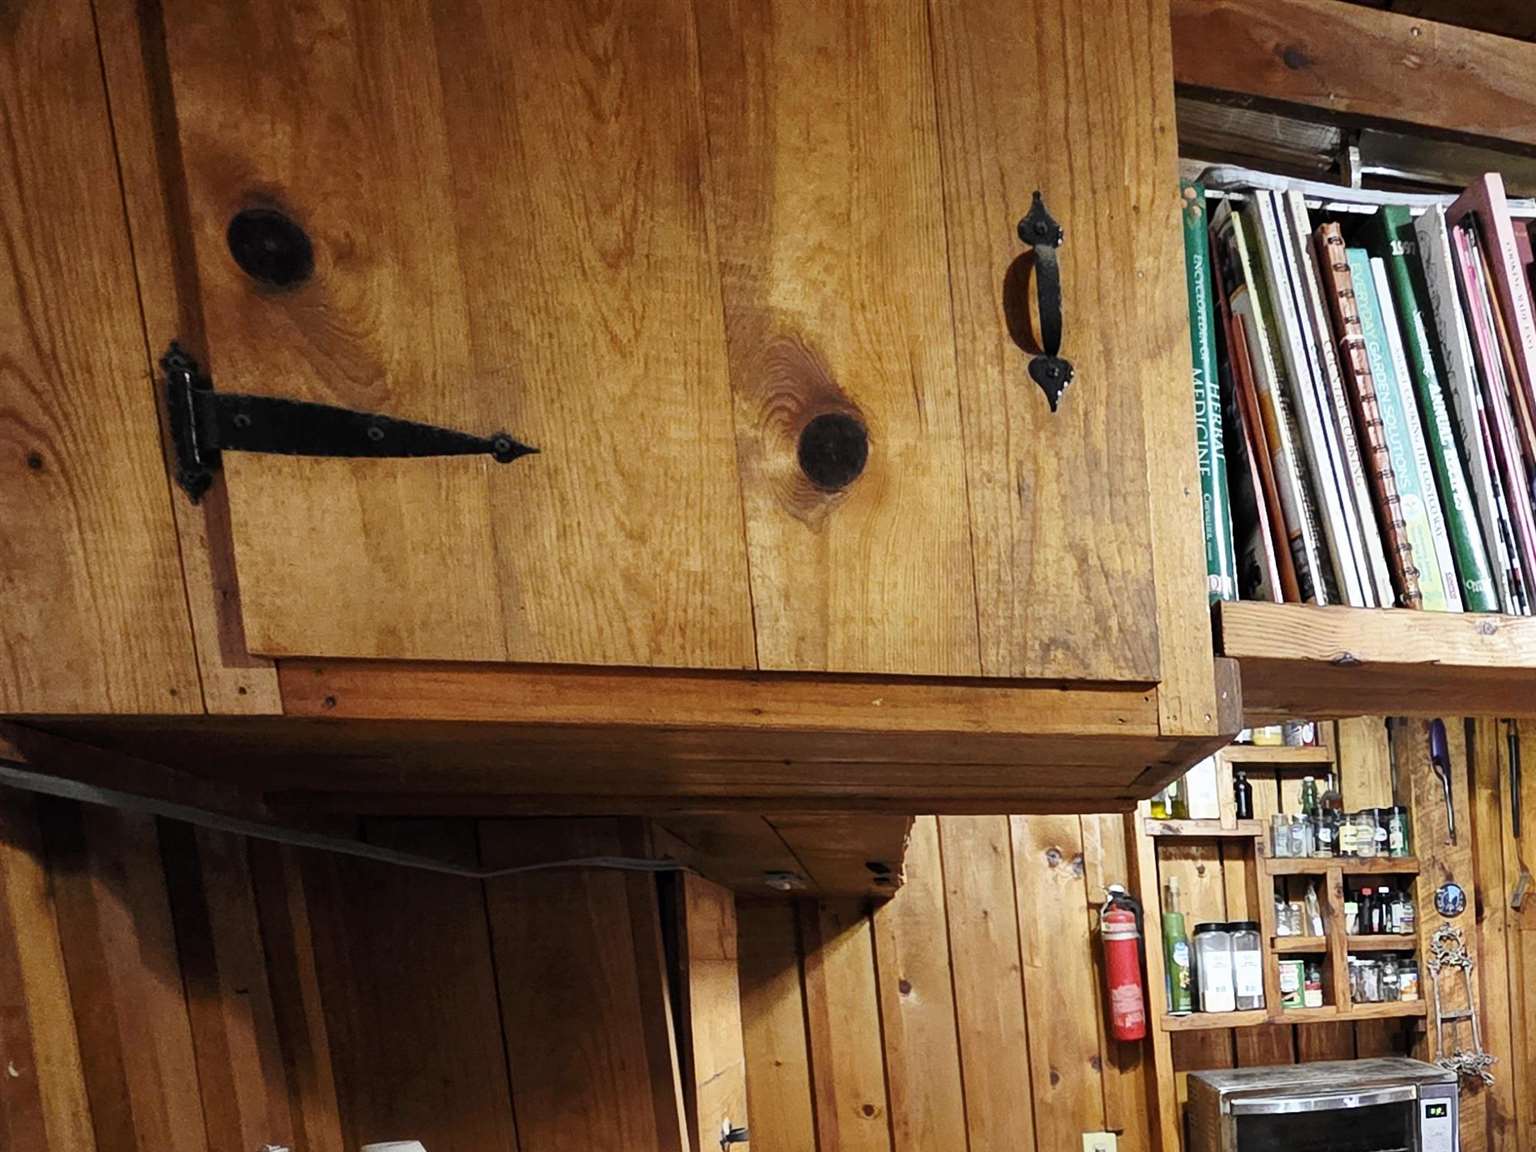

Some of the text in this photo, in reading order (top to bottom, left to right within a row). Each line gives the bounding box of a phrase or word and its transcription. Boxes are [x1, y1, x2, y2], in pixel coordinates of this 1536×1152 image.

[1192, 367, 1211, 477] MEDICINE
[1209, 382, 1226, 462] HERBAL
[1323, 339, 1364, 487] COUNTRY COOKING
[1351, 261, 1411, 490] EVERYDAY GARDEN SOLUTIONS
